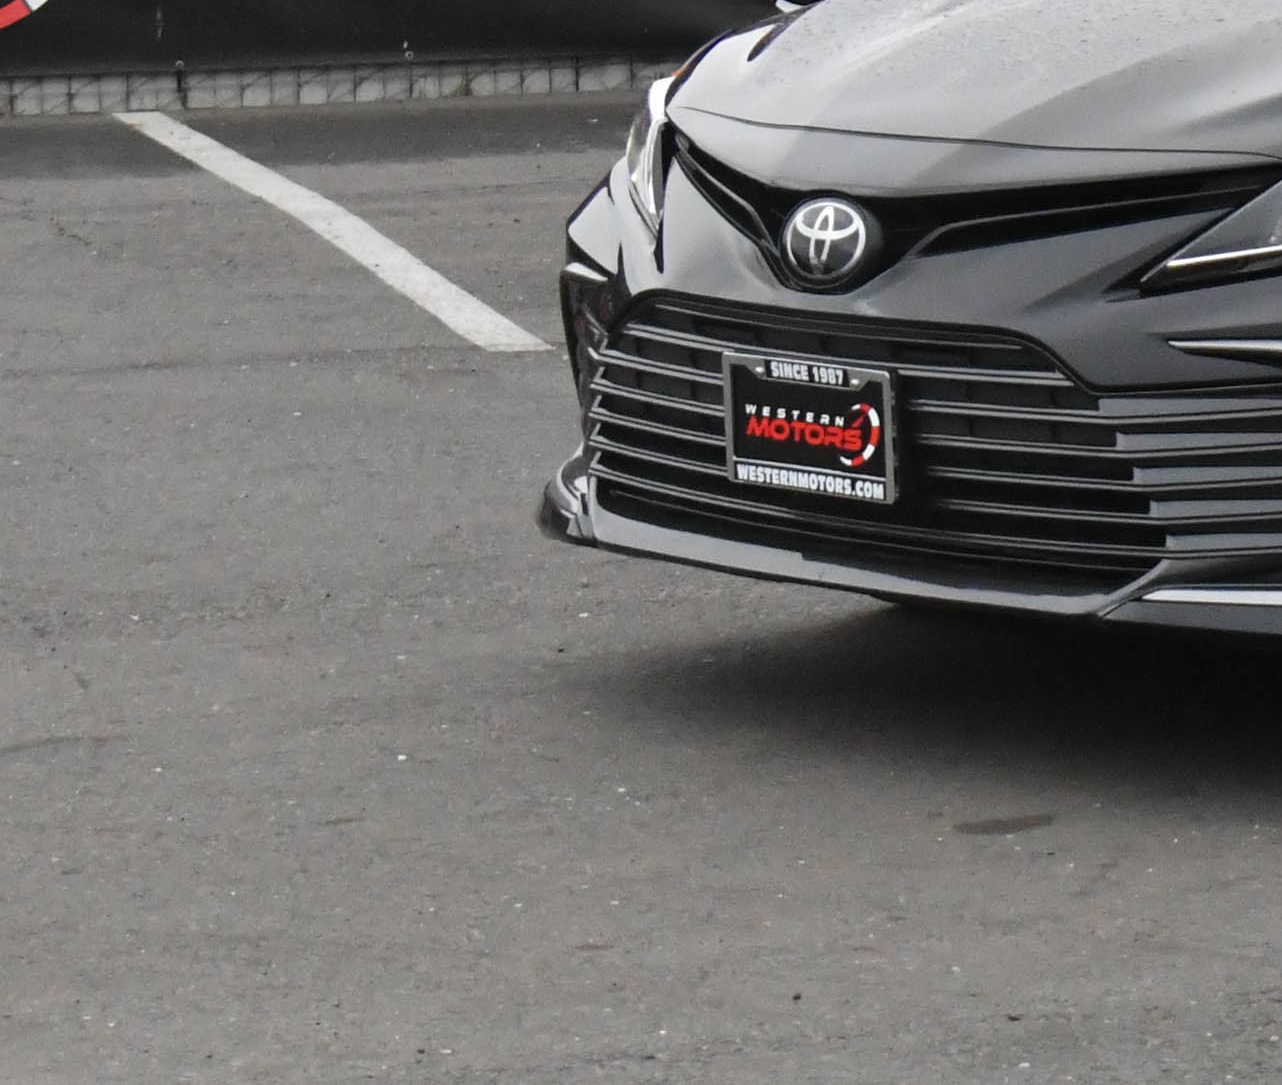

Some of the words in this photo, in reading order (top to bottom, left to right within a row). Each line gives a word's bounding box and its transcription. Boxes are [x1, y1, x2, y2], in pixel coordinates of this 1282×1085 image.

[770, 361, 809, 381] SINCE
[745, 403, 845, 427] WESTERN
[746, 416, 863, 451] MOTORS
[736, 464, 885, 500] WESTERNMOTORS.COM
